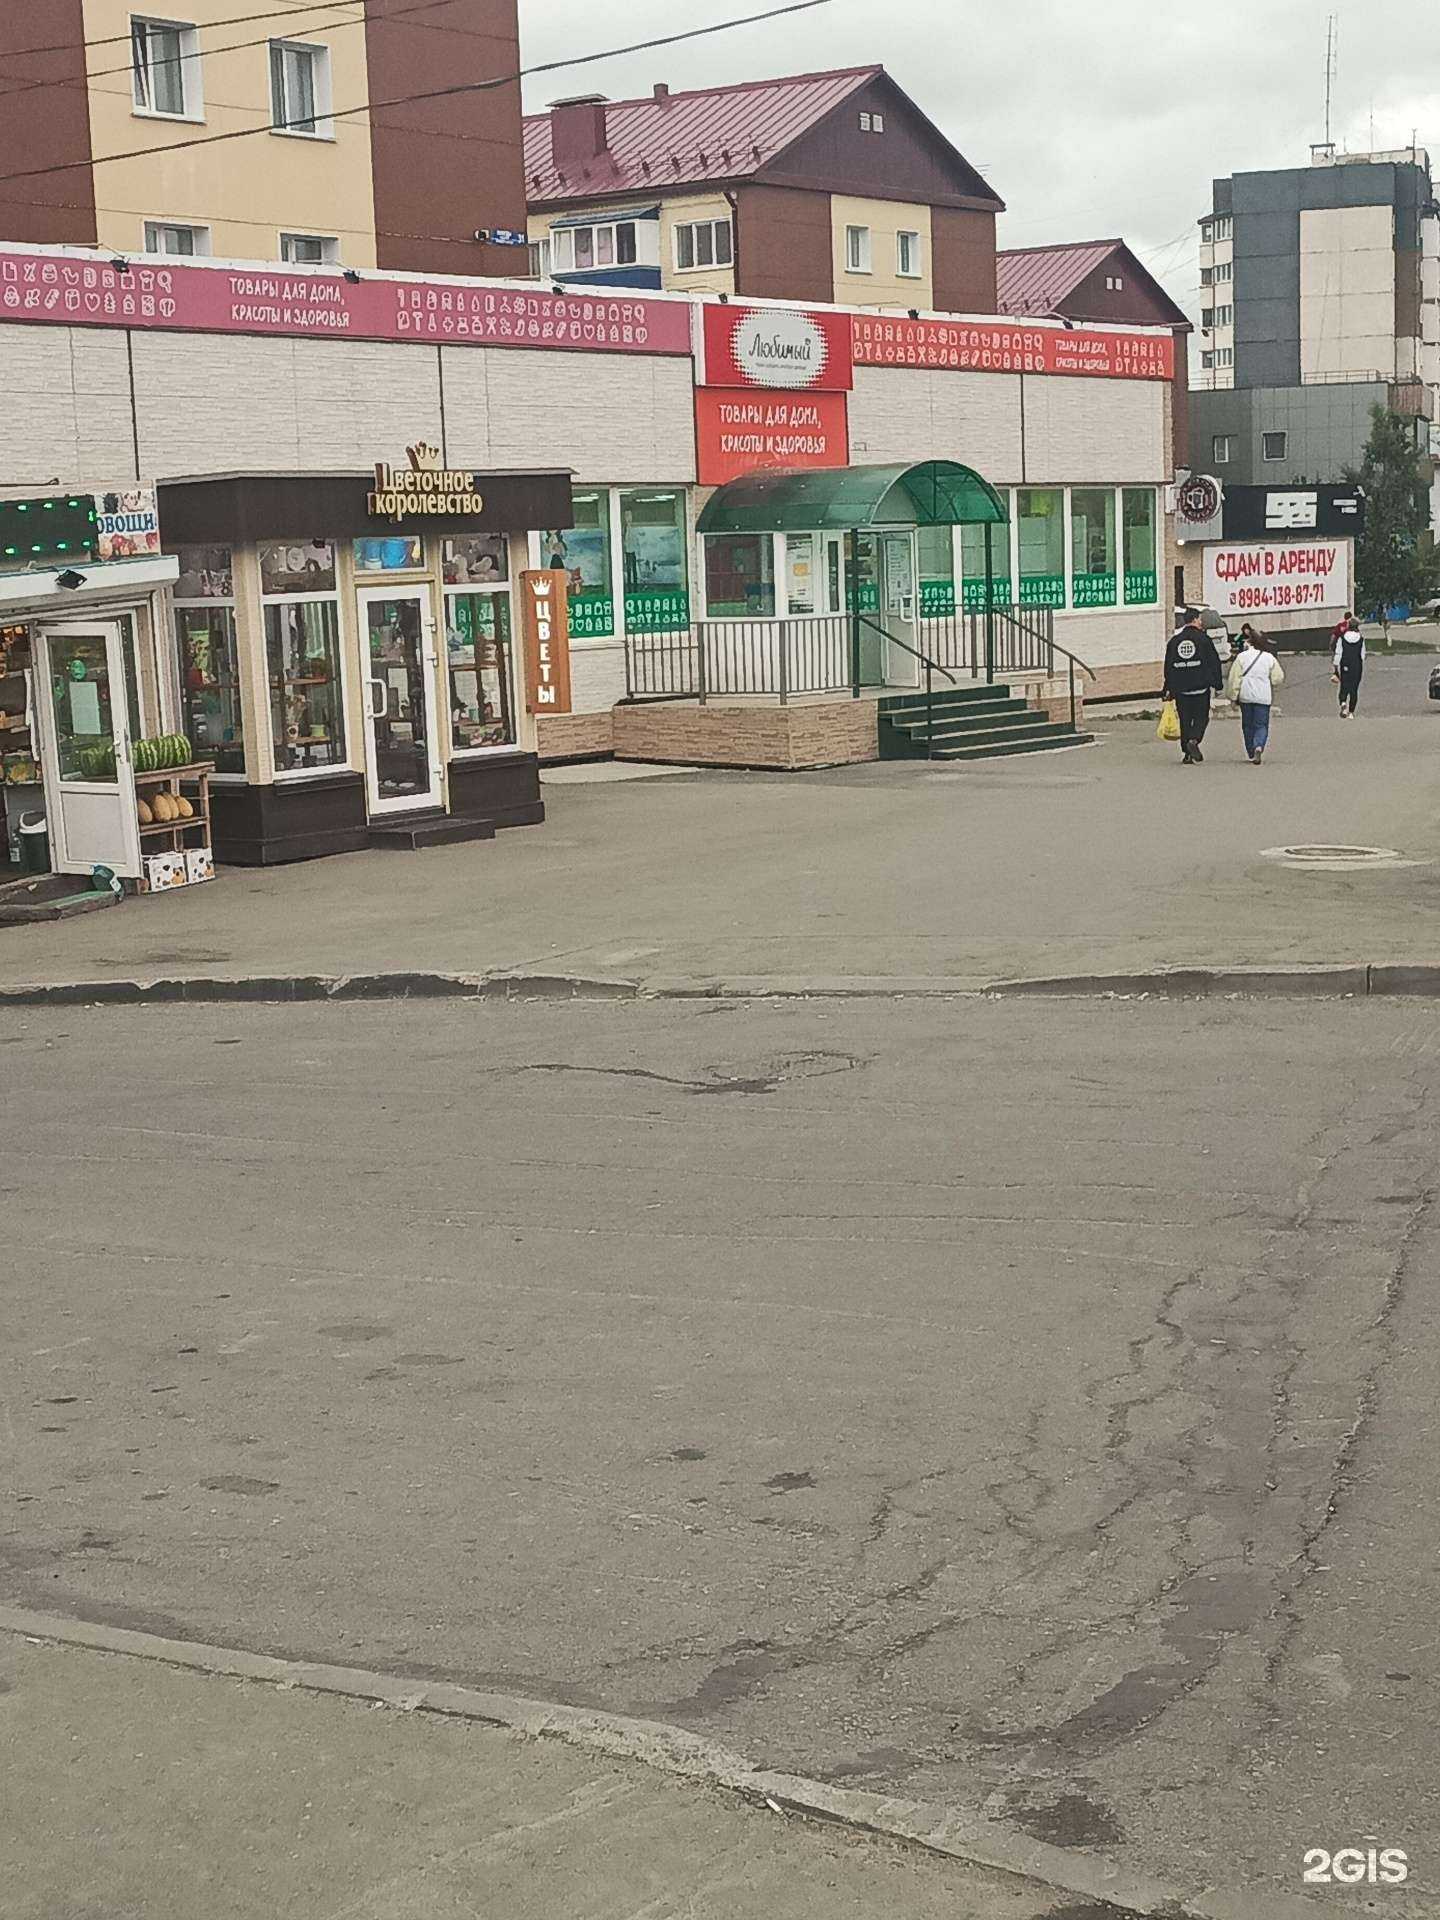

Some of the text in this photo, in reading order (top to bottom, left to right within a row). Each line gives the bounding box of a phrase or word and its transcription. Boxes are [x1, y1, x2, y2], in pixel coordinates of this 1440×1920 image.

[229, 277, 345, 305] ТОВАРЫ ДЛЯ ДОМА,
[231, 304, 350, 327] КРАСОТЫ И ЗДОРОВЬЯ
[748, 333, 811, 361] Любимый
[719, 404, 822, 429] ТОВАРЫ ДЛЯ ДОМА,
[721, 435, 826, 455] КРАСОТЫ И ЗДОРОВЬЯ
[376, 463, 474, 494] Цветочное
[375, 493, 483, 521] королевство
[1216, 548, 1336, 582] СДАМ В АРЕНДУ
[536, 601, 555, 704] ЦВЕТЫ
